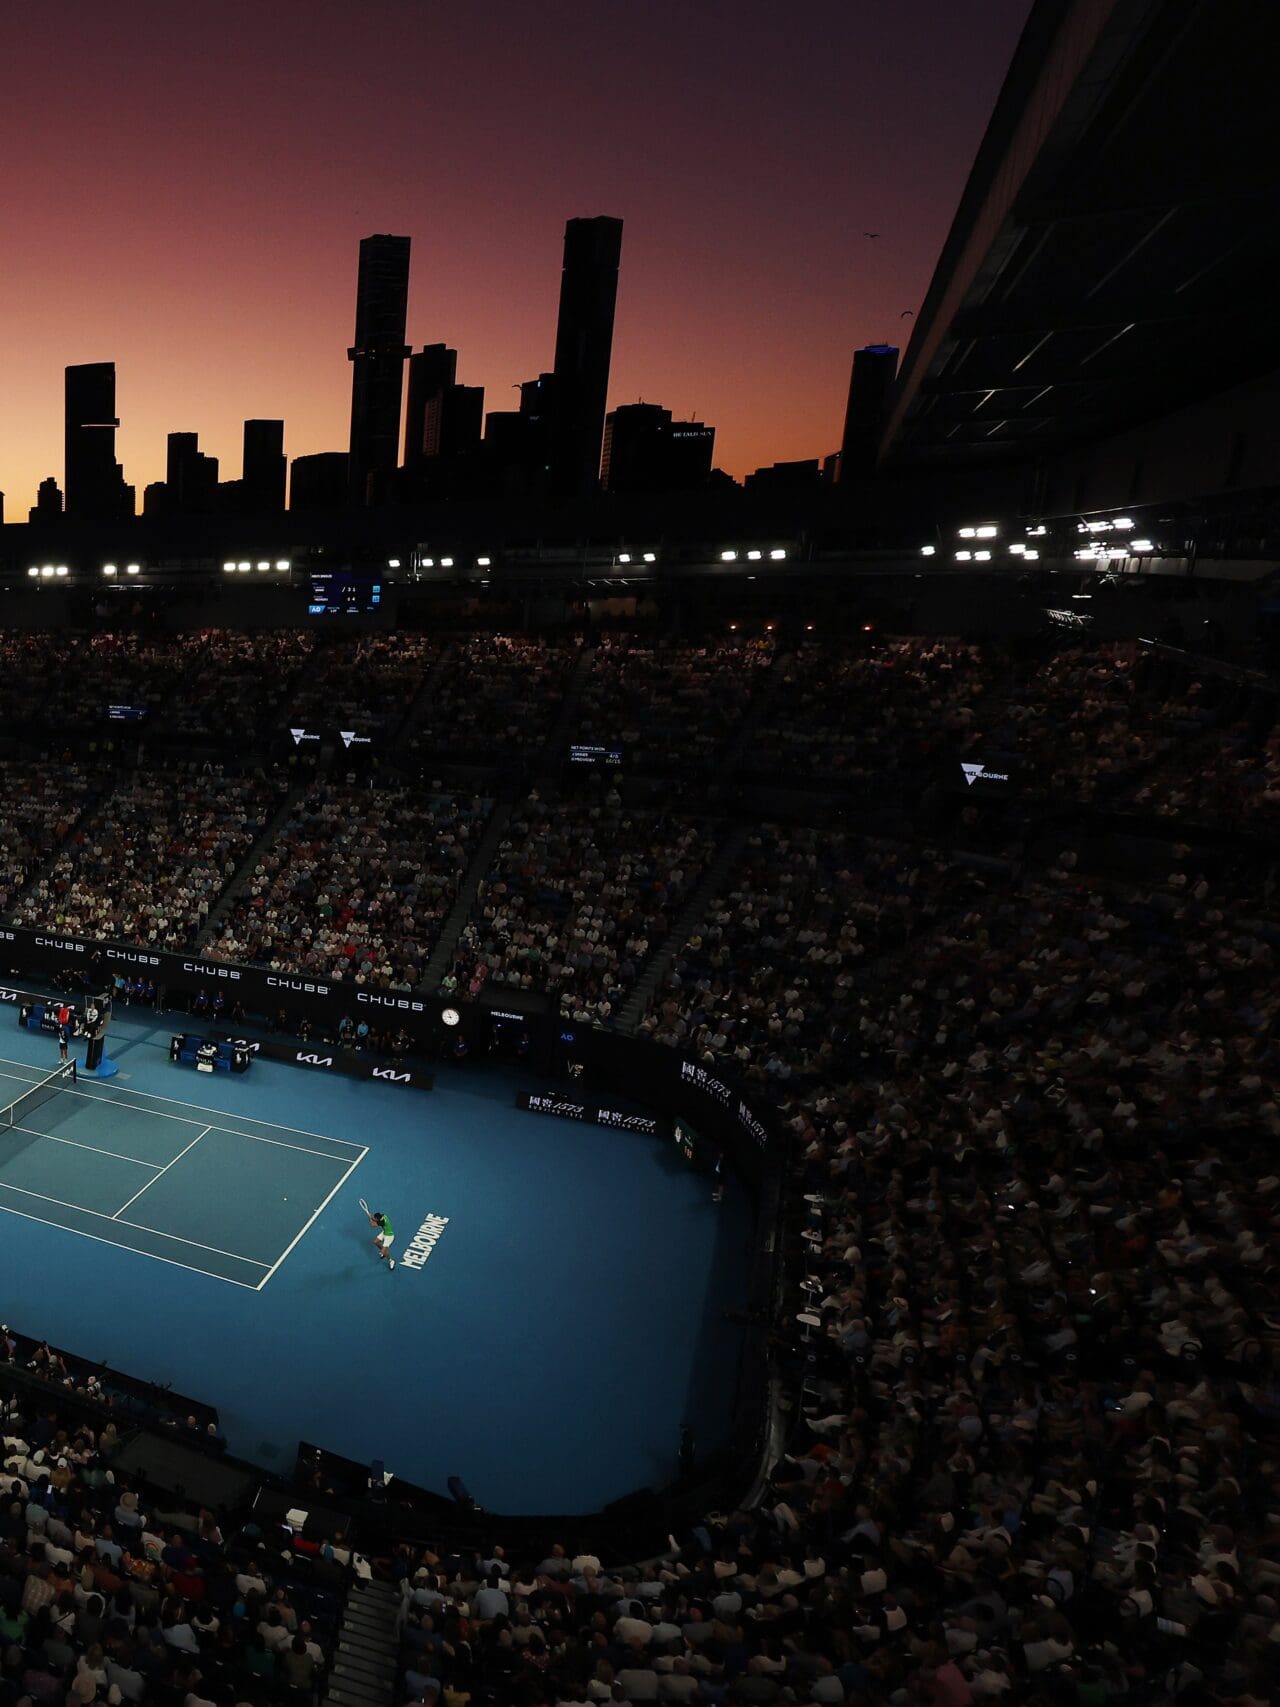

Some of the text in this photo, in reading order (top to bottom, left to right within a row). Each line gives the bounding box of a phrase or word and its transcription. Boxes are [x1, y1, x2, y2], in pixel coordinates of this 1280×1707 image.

[35, 937, 85, 952] CHUBB
[106, 949, 160, 965] CHUBB
[183, 962, 241, 980] CHUBB
[266, 976, 329, 995] CHUBB
[356, 992, 425, 1012] CHUBB
[490, 1010, 524, 1021] MELBOURNE
[296, 1051, 333, 1067] KIA
[372, 1067, 411, 1082] KIA
[553, 1102, 584, 1113] 1573
[624, 1116, 656, 1128] 1573
[399, 1212, 450, 1270] MELBOURNE
